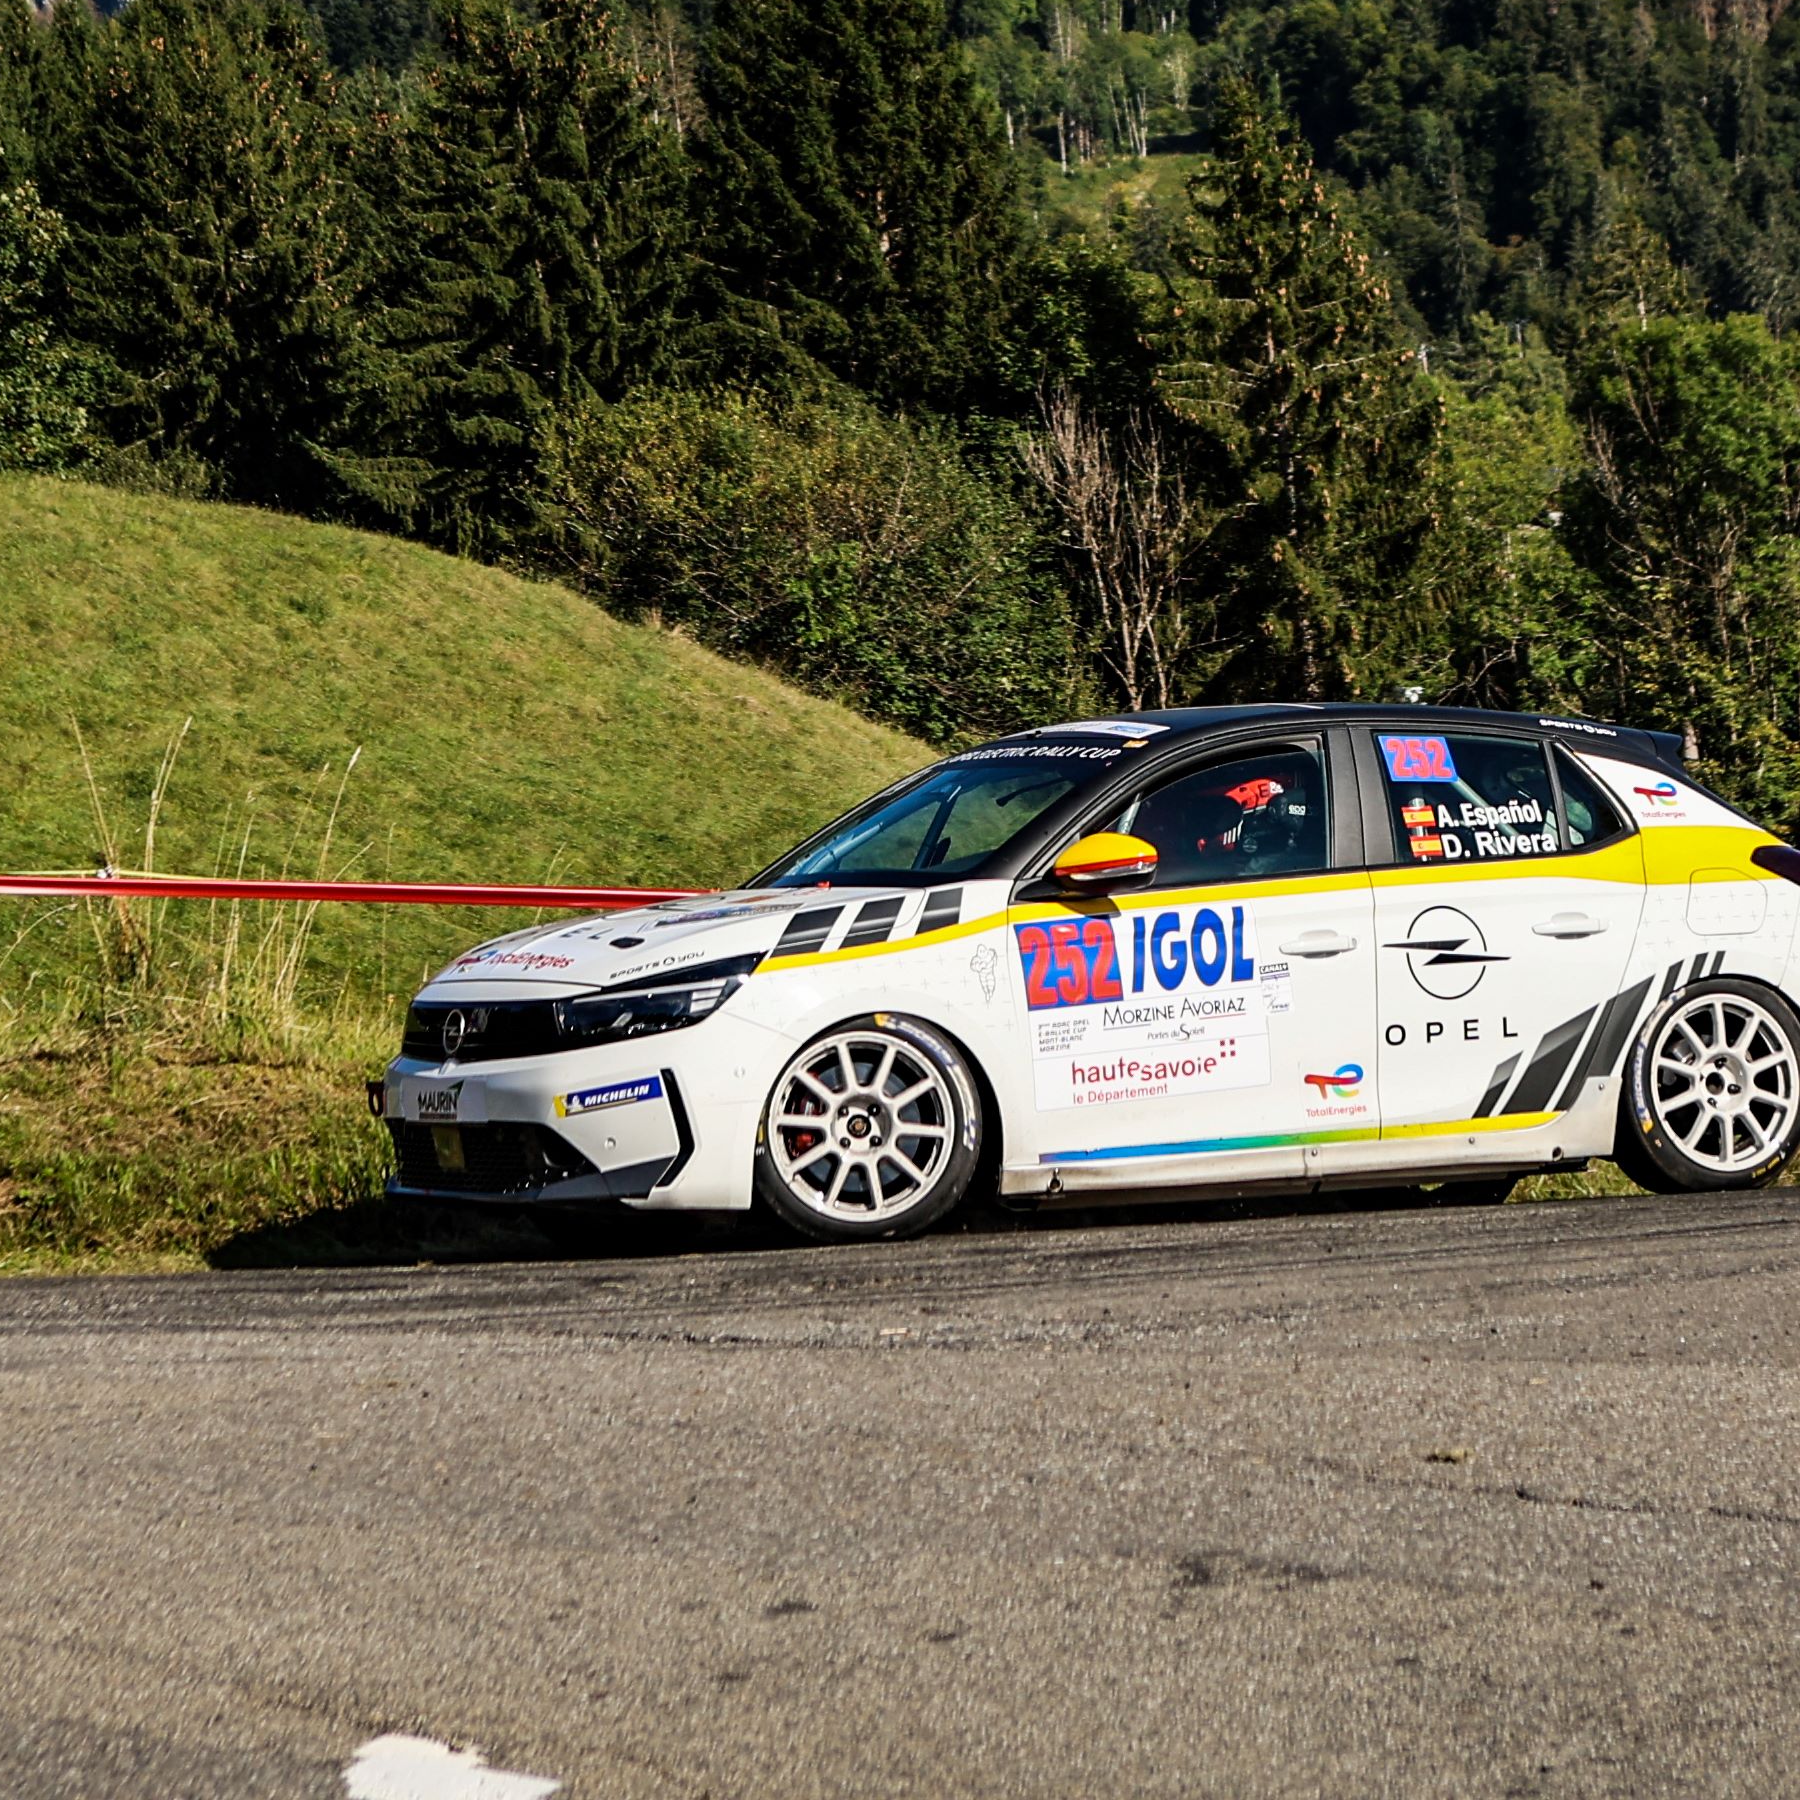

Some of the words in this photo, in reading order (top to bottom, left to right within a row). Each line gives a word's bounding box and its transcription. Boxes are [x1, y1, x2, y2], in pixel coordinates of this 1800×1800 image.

[1029, 746, 1086, 758] RALLY
[1079, 747, 1122, 759] CUP
[1386, 738, 1453, 779] 252
[1438, 804, 1459, 828] A.
[1460, 798, 1544, 828] Español
[1444, 834, 1470, 858] D.
[1475, 830, 1558, 855] Rivera
[1019, 918, 1122, 1006] 252
[1131, 906, 1255, 993] IGOL
[609, 961, 660, 979] SPORTS
[1103, 1004, 1175, 1027] MORZINE
[1180, 996, 1246, 1019] AVORIAZ
[1385, 1017, 1518, 1046] OPEL
[1072, 1056, 1217, 1085] hautesavoie
[417, 1089, 458, 1112] MAURIN
[584, 1084, 650, 1107] MICHELIN
[1073, 1092, 1084, 1105] le
[1088, 1083, 1169, 1104] Département
[1306, 1104, 1367, 1118] TotalEnergies
